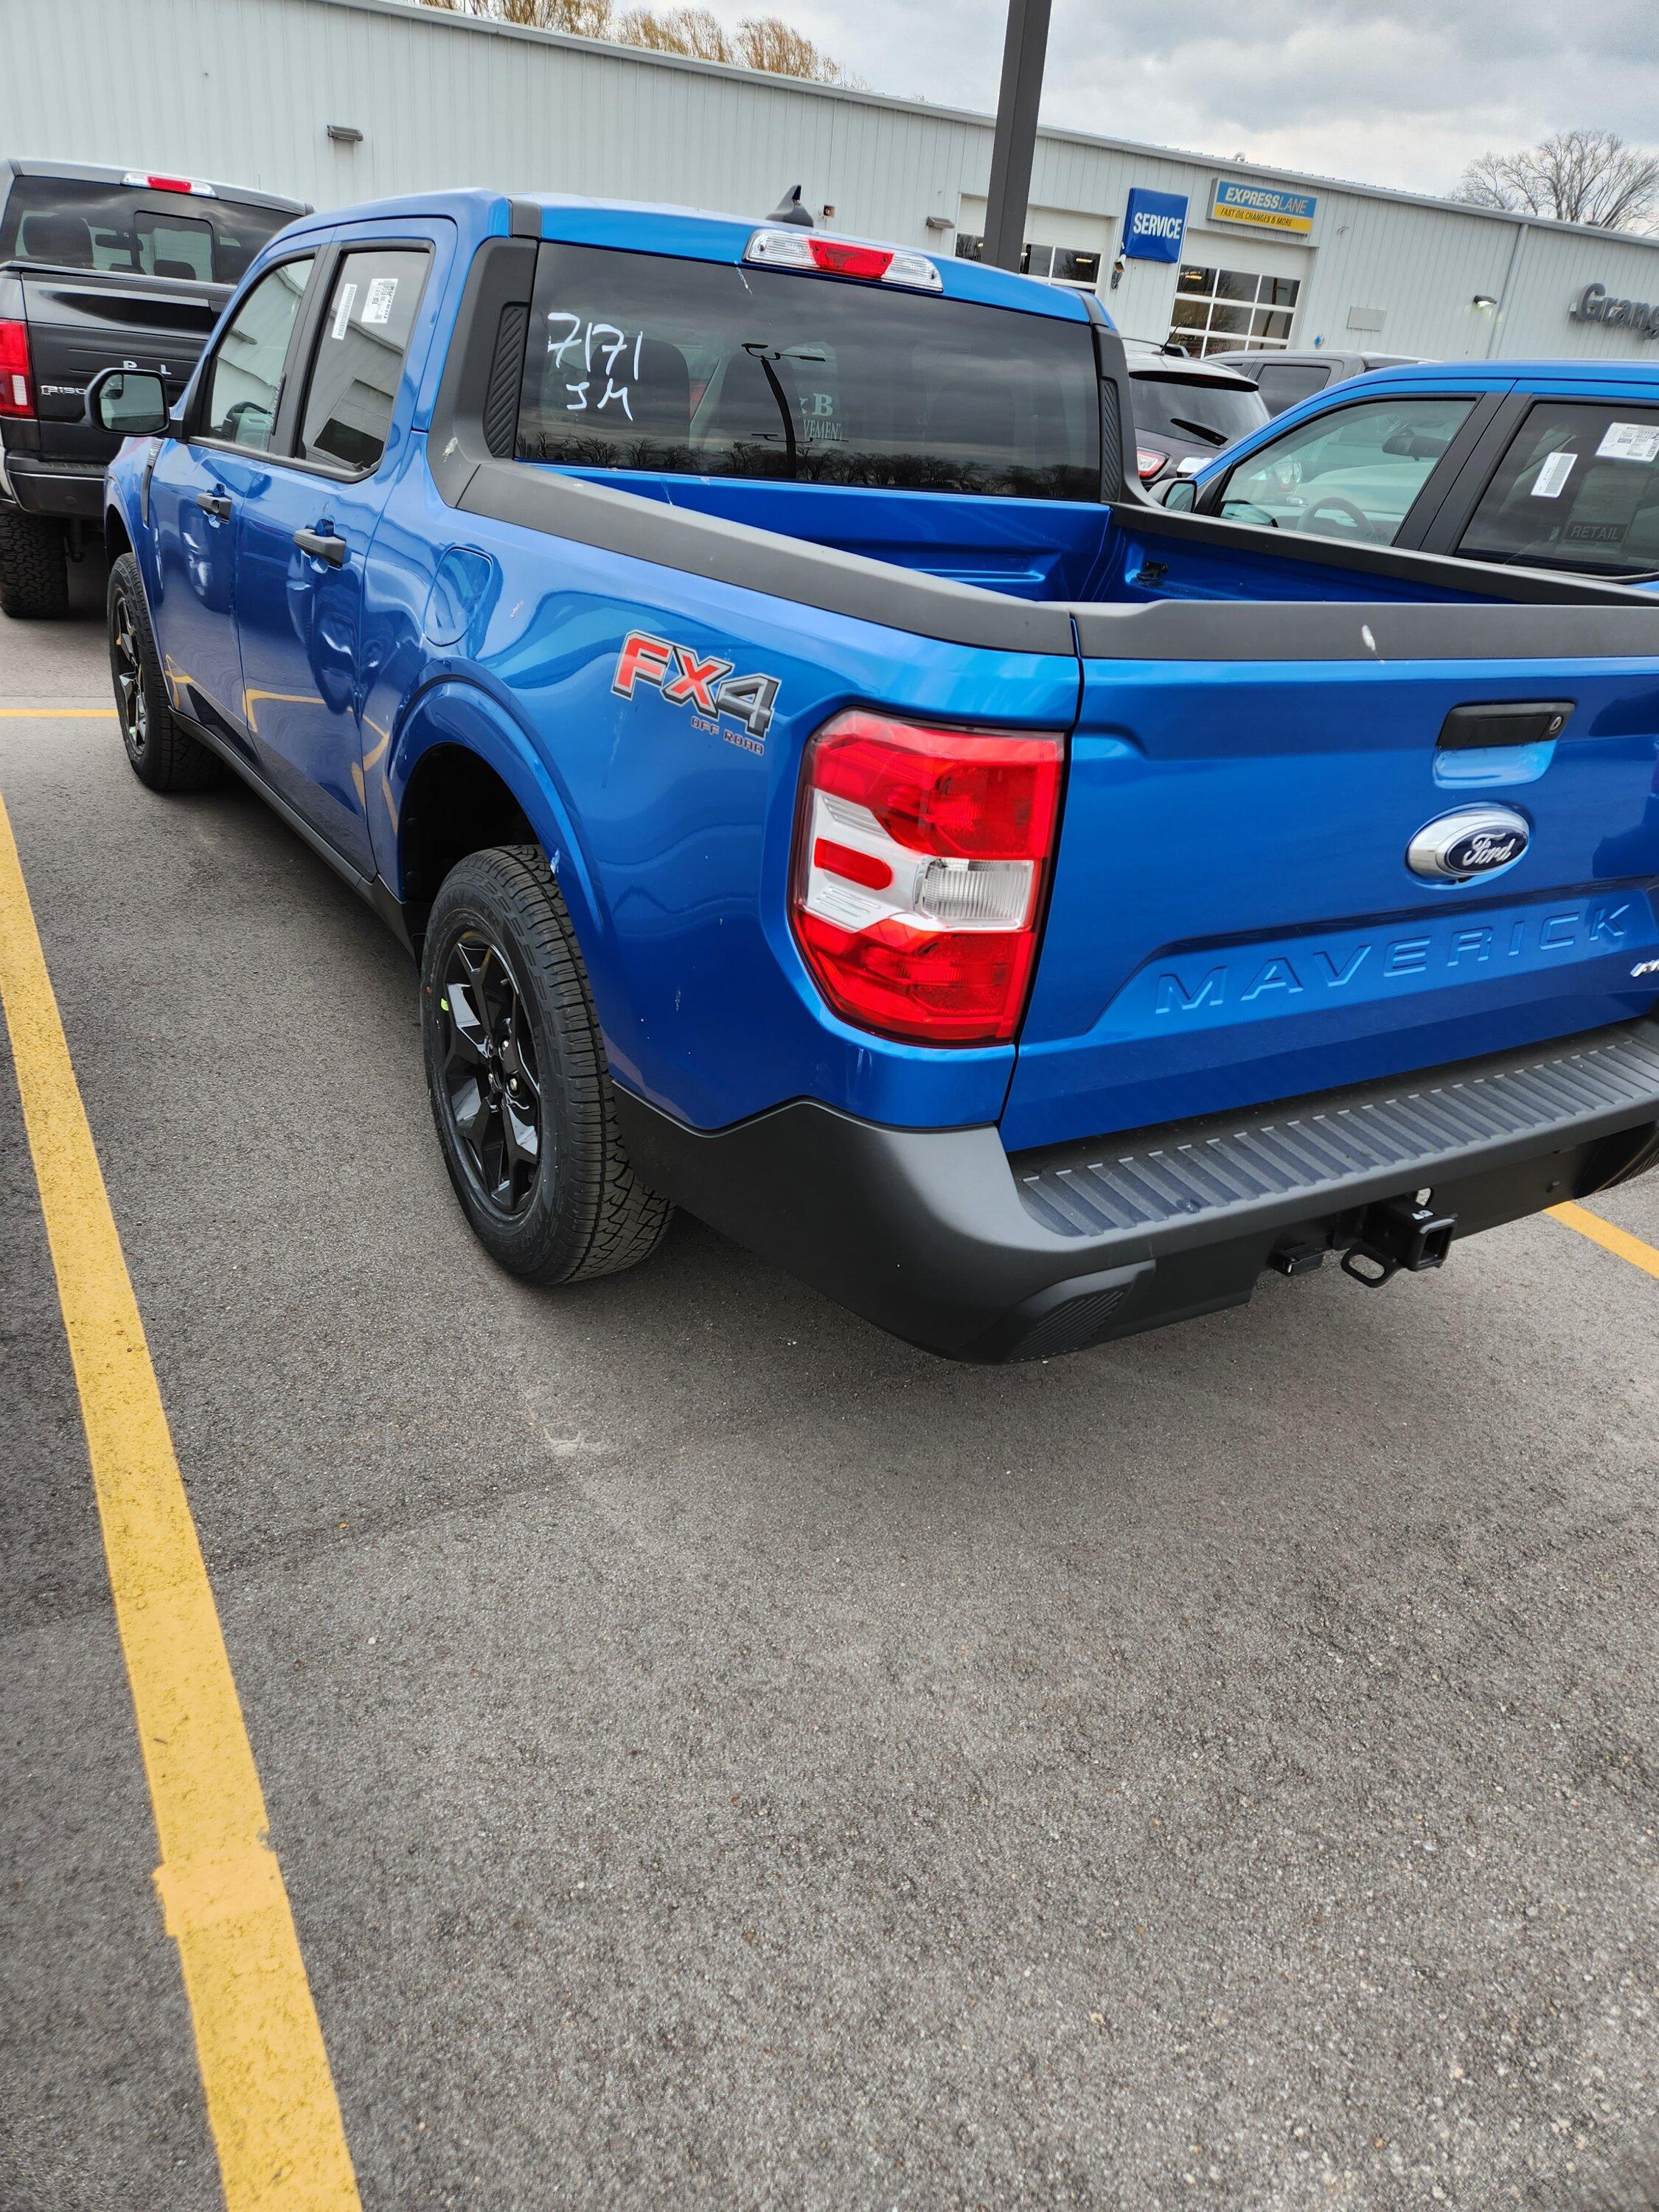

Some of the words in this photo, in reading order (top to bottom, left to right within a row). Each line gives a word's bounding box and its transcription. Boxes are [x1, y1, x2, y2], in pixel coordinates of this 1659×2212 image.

[1133, 212, 1182, 240] SERVICE
[1221, 207, 1236, 217] FAST
[1236, 210, 1245, 219] OIL
[1245, 212, 1271, 223] CHANGES
[1276, 217, 1293, 227] MORE
[548, 313, 643, 380] 7171
[1570, 525, 1619, 540] RETAIL
[611, 629, 782, 740] FX4
[690, 716, 720, 735] OFF
[723, 731, 765, 757] ROAD
[1462, 832, 1516, 866] Ford
[1155, 904, 1631, 1014] MAVERICK
